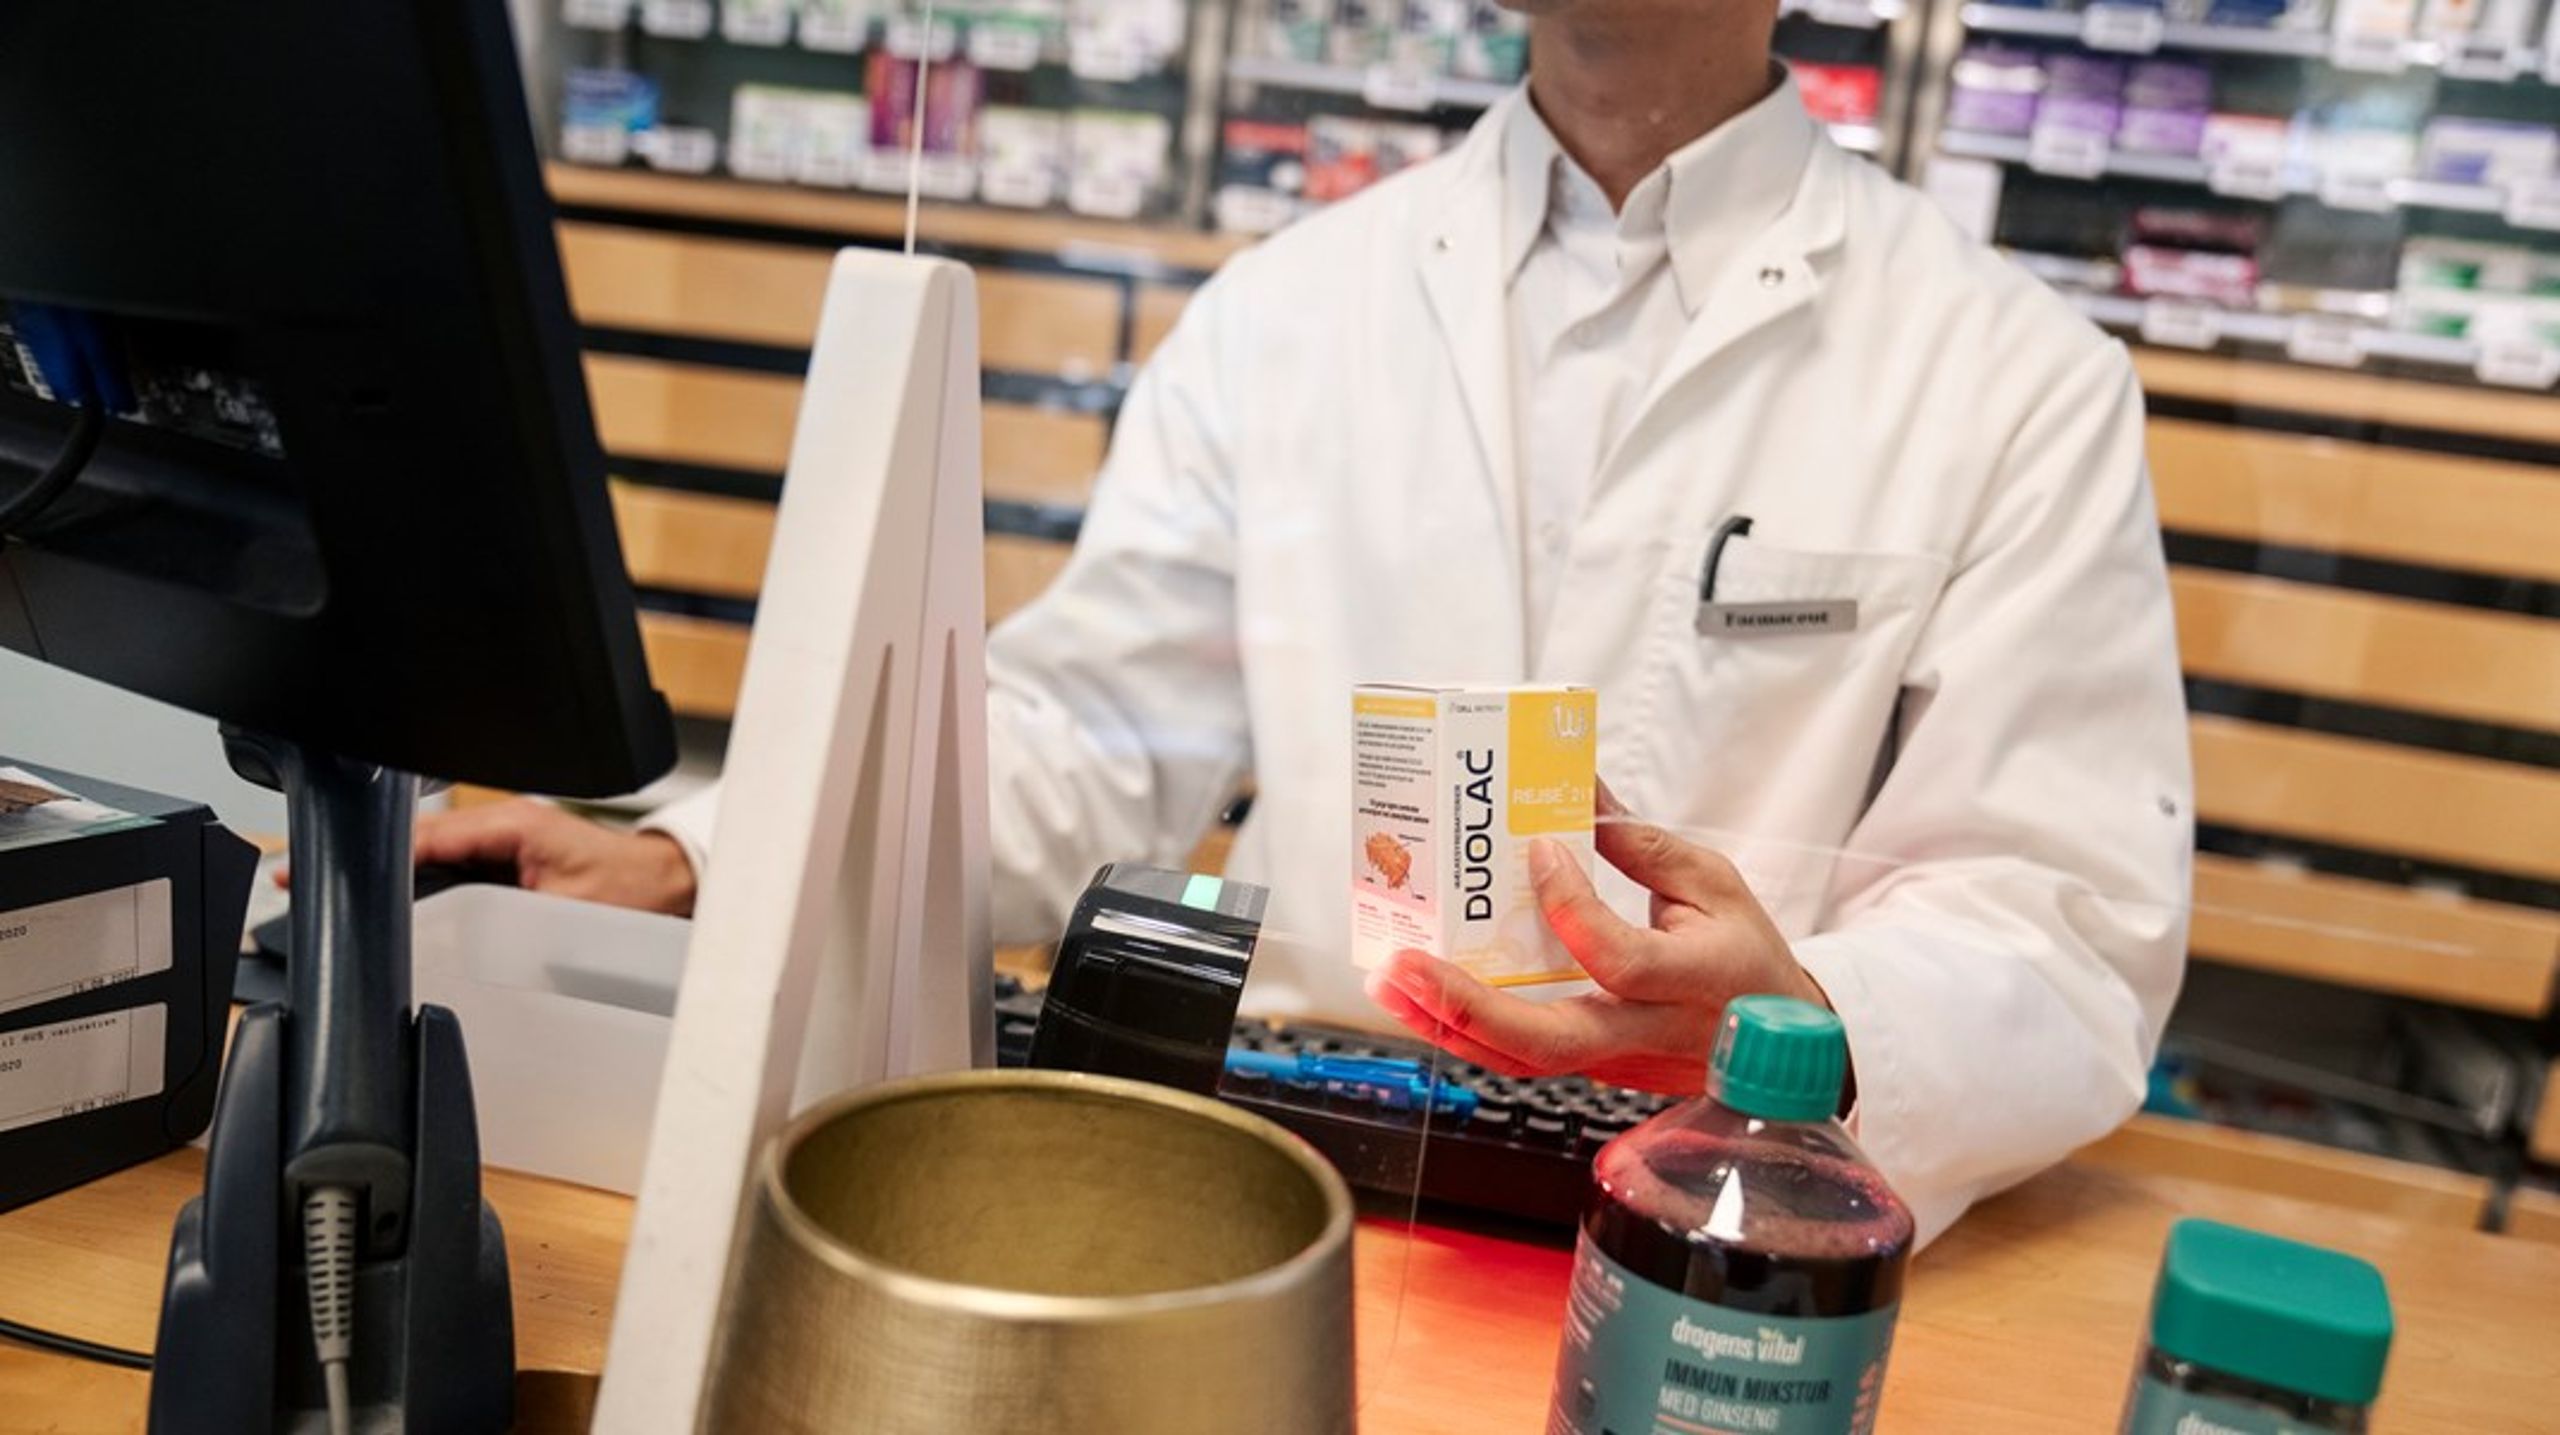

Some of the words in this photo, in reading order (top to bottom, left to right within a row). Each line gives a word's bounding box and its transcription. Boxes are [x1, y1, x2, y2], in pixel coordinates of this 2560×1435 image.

[1465, 749, 1493, 921] DUOLAC
[1671, 1315, 1753, 1361] drogens
[1664, 1357, 1737, 1398] IMMUN
[1742, 1376, 1830, 1404] MIKSTUR
[1657, 1385, 1697, 1418] MED
[1700, 1399, 1780, 1432] GINSENG
